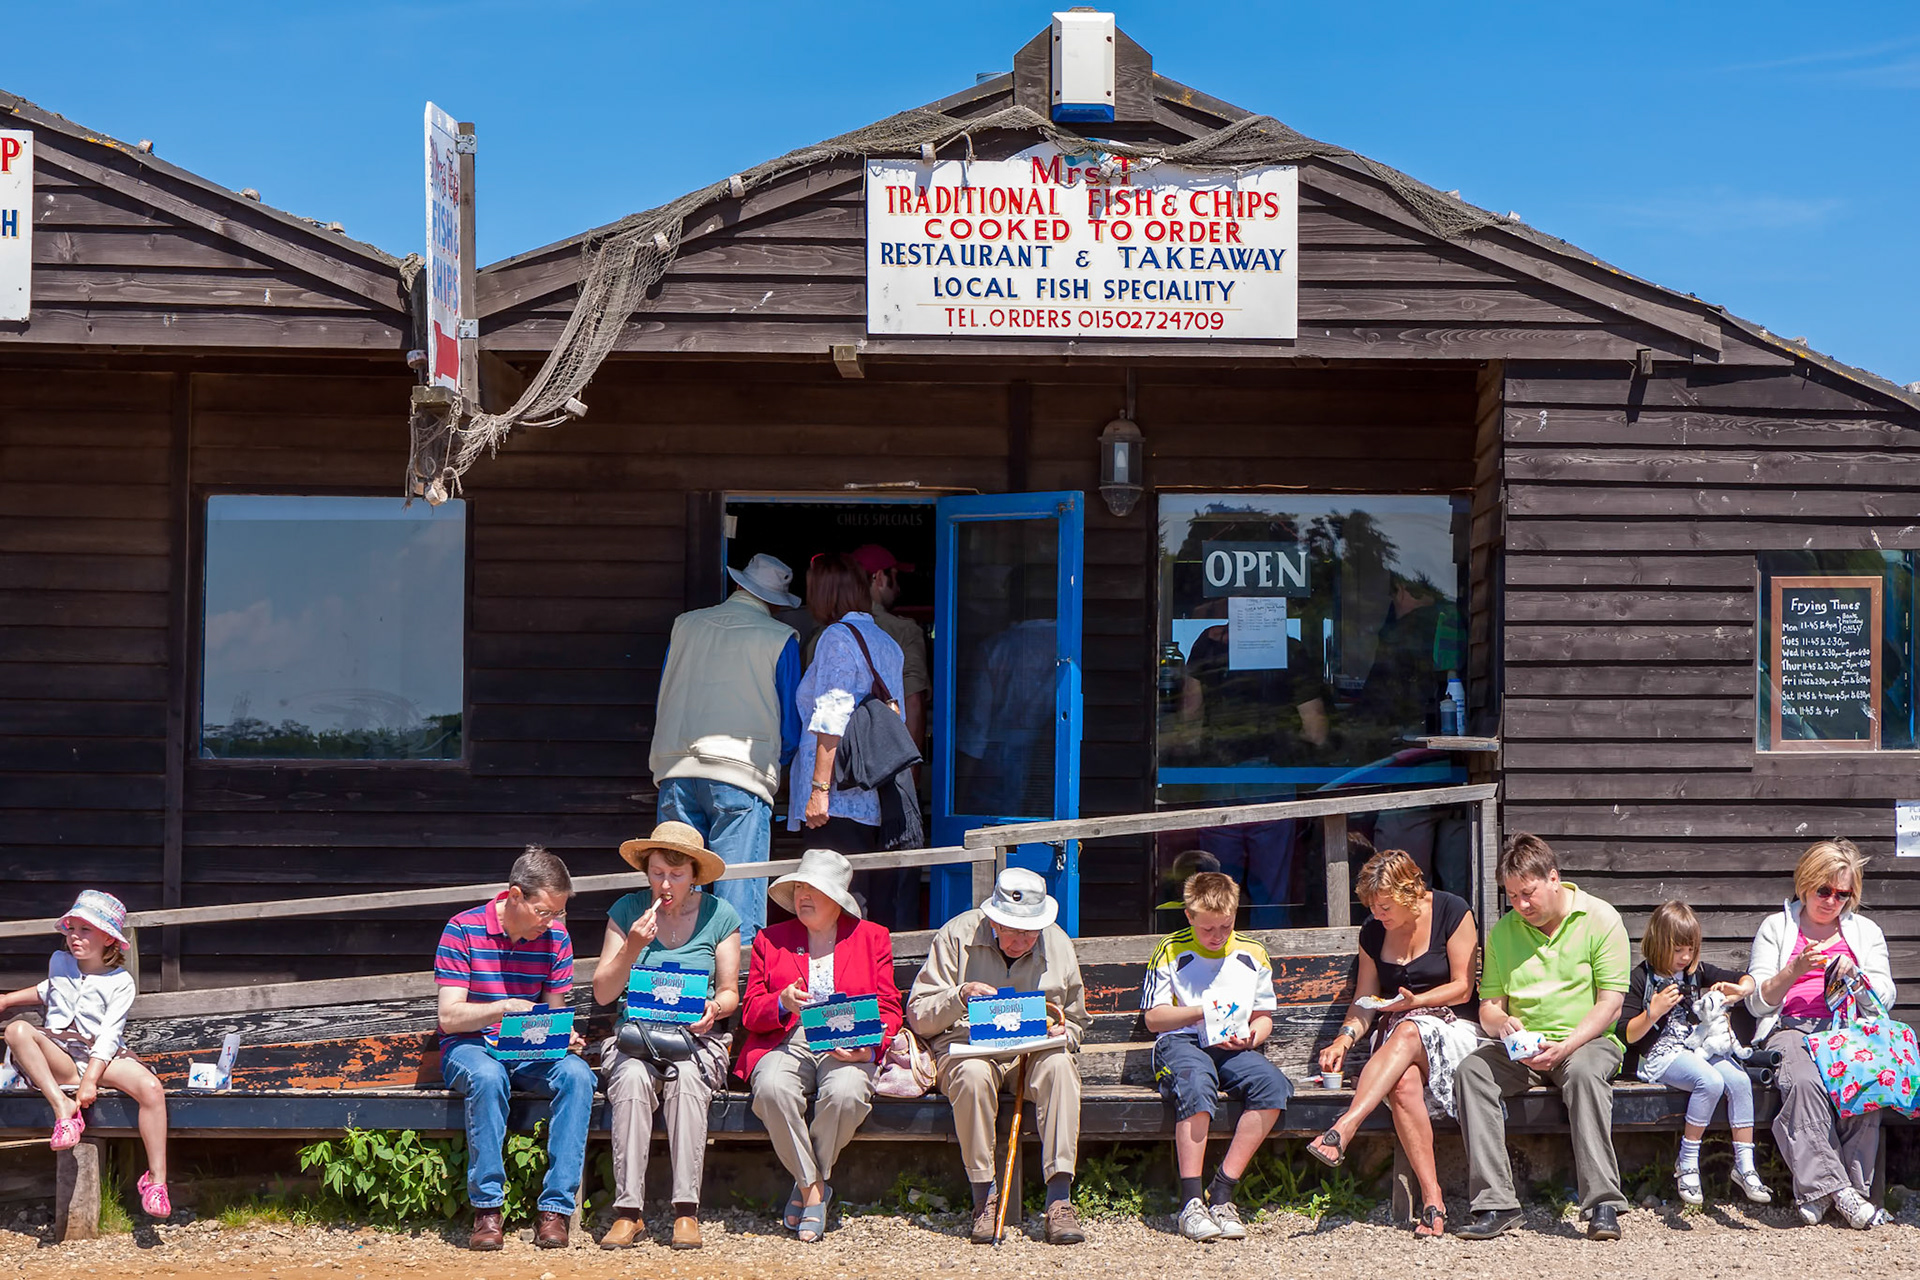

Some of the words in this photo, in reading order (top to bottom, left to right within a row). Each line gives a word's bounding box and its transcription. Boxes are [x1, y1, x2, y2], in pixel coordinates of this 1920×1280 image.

[886, 186, 1059, 216] TRADITIONAL
[1088, 188, 1152, 217] FISH
[1161, 194, 1178, 217] &
[1190, 191, 1279, 218] CHIPS
[433, 200, 453, 252] FISH
[924, 219, 1070, 241] COOKED
[1088, 220, 1132, 241] TO
[1145, 220, 1241, 243] ORDER
[881, 243, 1052, 268] RESTAURANT
[1075, 250, 1090, 268] &
[1117, 246, 1286, 271] TAKEAWAY
[432, 255, 459, 315] CHIPS
[934, 276, 1018, 298] LOCAL
[1037, 278, 1089, 299] FISH
[1104, 279, 1236, 301] SPECIALITY
[1078, 310, 1224, 330] 01502724709
[872, 513, 922, 526] SPECIALS
[1206, 550, 1307, 587] OPEN
[1791, 598, 1827, 615] Frying
[1829, 599, 1860, 611] Times
[1782, 623, 1798, 631] Mon
[1842, 625, 1862, 636] ONLY
[1781, 635, 1799, 646] Tues
[1782, 648, 1799, 657] Wed
[1781, 658, 1801, 671] Thur
[1782, 675, 1796, 685] Fri
[1782, 690, 1795, 700] Sat
[1782, 705, 1797, 715] Sun
[1824, 706, 1839, 717] 4pm
